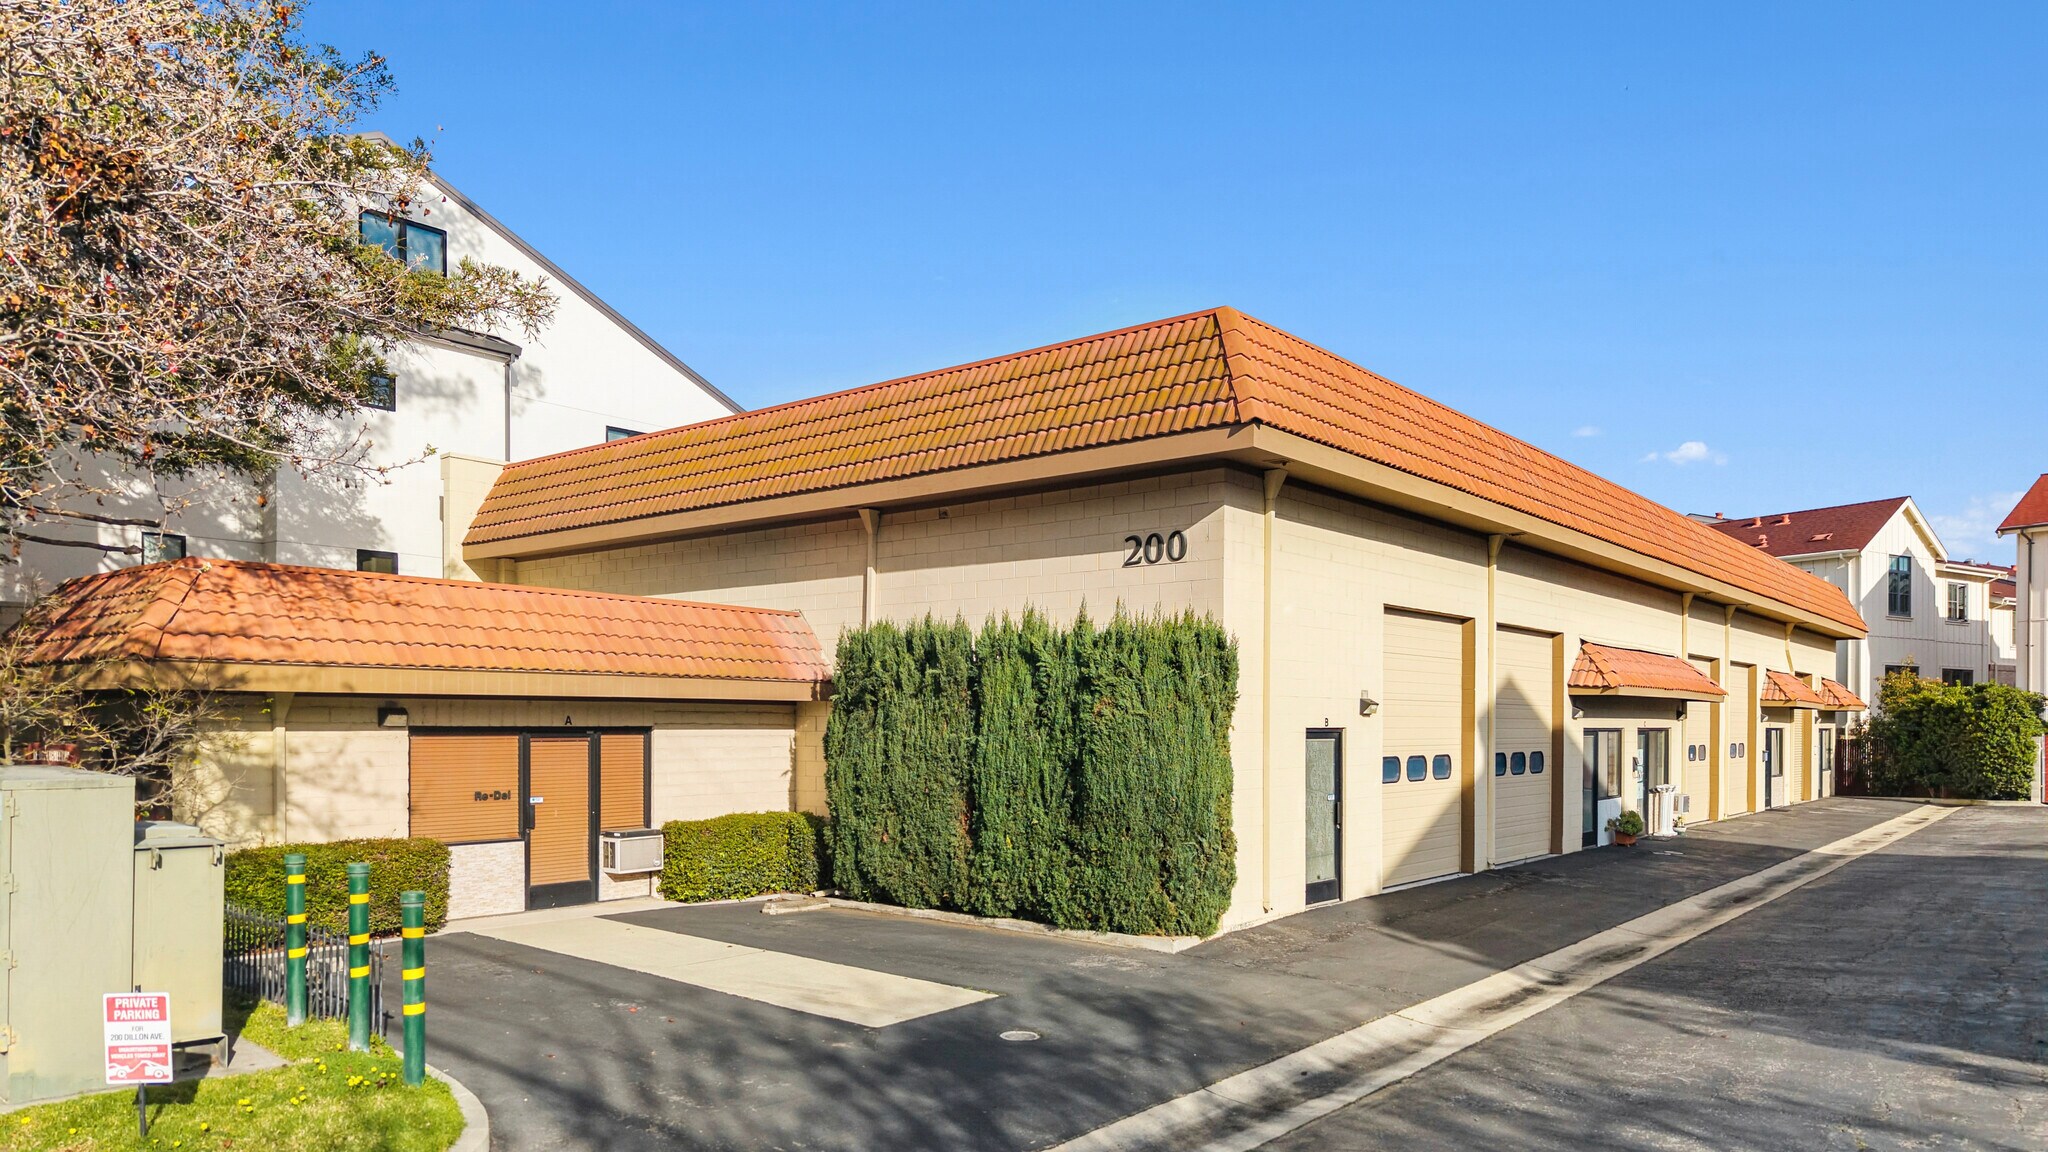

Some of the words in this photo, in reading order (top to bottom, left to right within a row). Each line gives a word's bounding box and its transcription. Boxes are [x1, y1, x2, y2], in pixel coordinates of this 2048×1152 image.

[1123, 530, 1187, 567] 200
[565, 715, 572, 725] A
[1325, 717, 1329, 727] B
[115, 997, 158, 1008] PRIVATE
[113, 1009, 160, 1020] PARKING
[124, 1033, 149, 1041] DILLON
